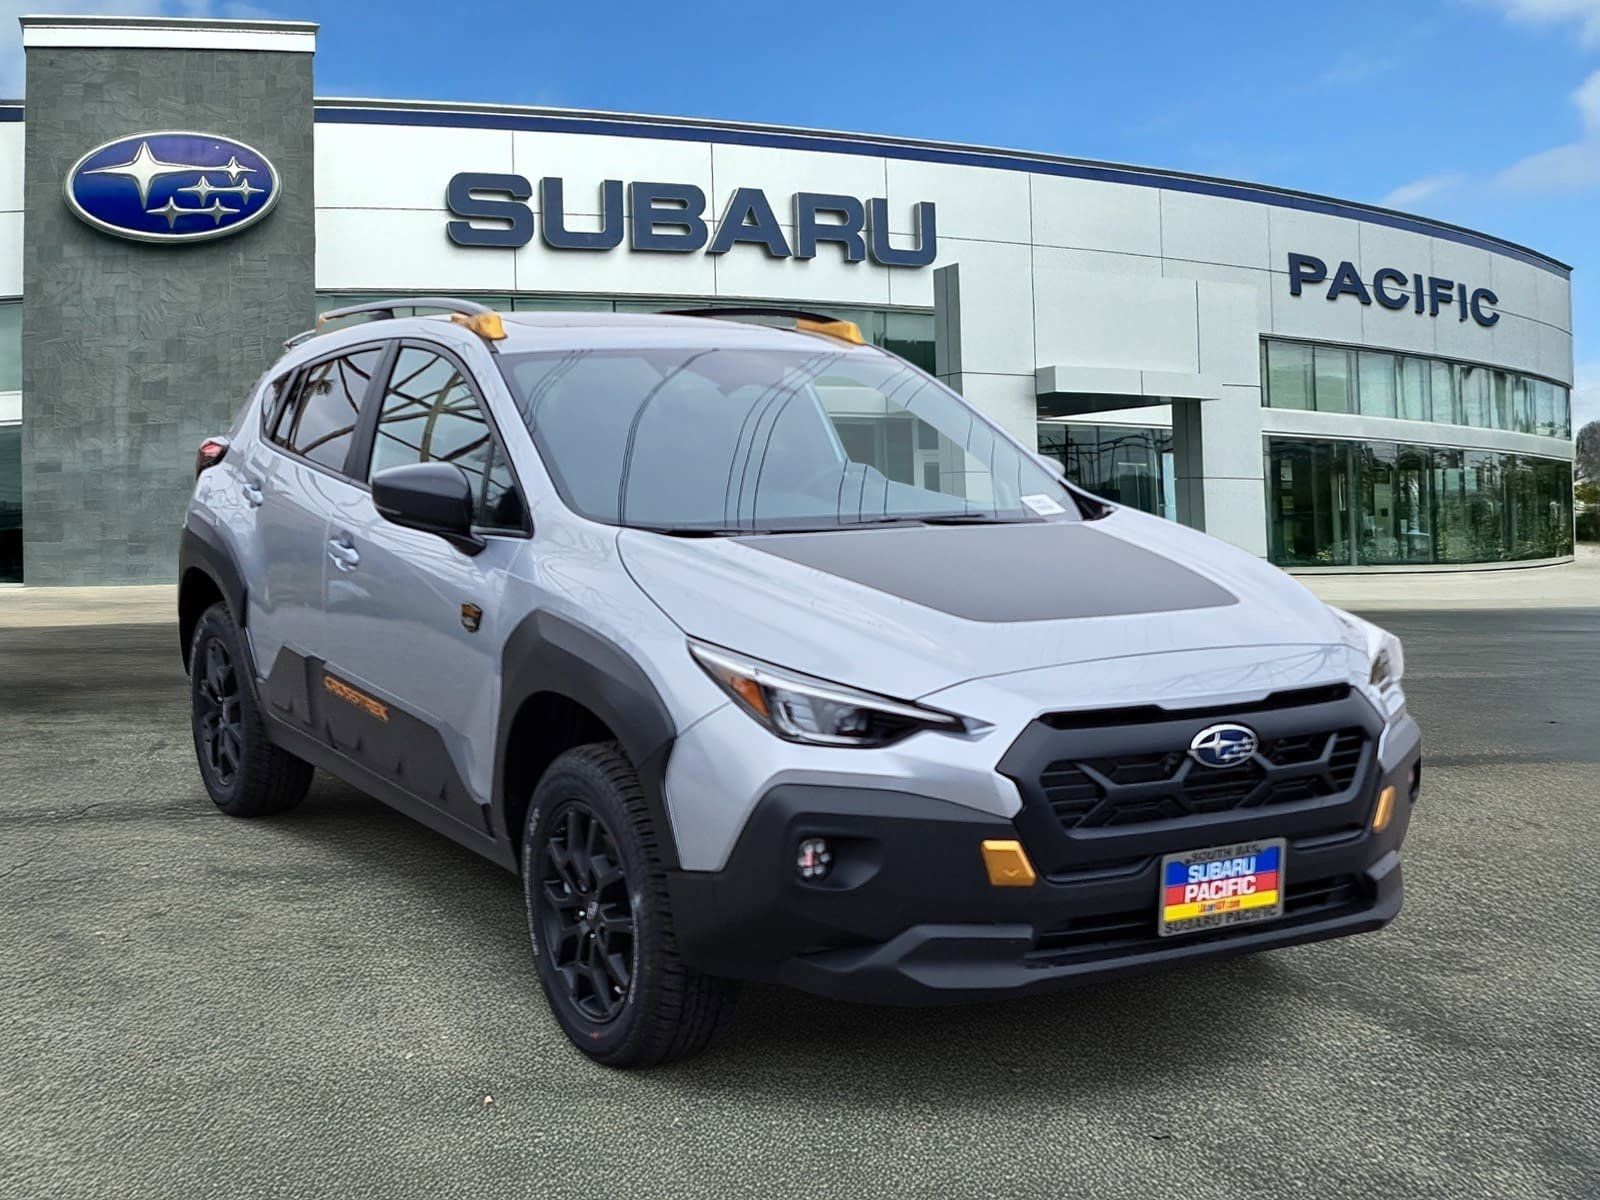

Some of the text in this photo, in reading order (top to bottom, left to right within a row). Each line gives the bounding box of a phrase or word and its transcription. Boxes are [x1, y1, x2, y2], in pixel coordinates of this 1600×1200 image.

[446, 171, 937, 268] SUBARU
[1287, 251, 1500, 328] PACIFIC
[1184, 875, 1257, 904] PACIFIC
[1187, 854, 1257, 884] SUBARU
